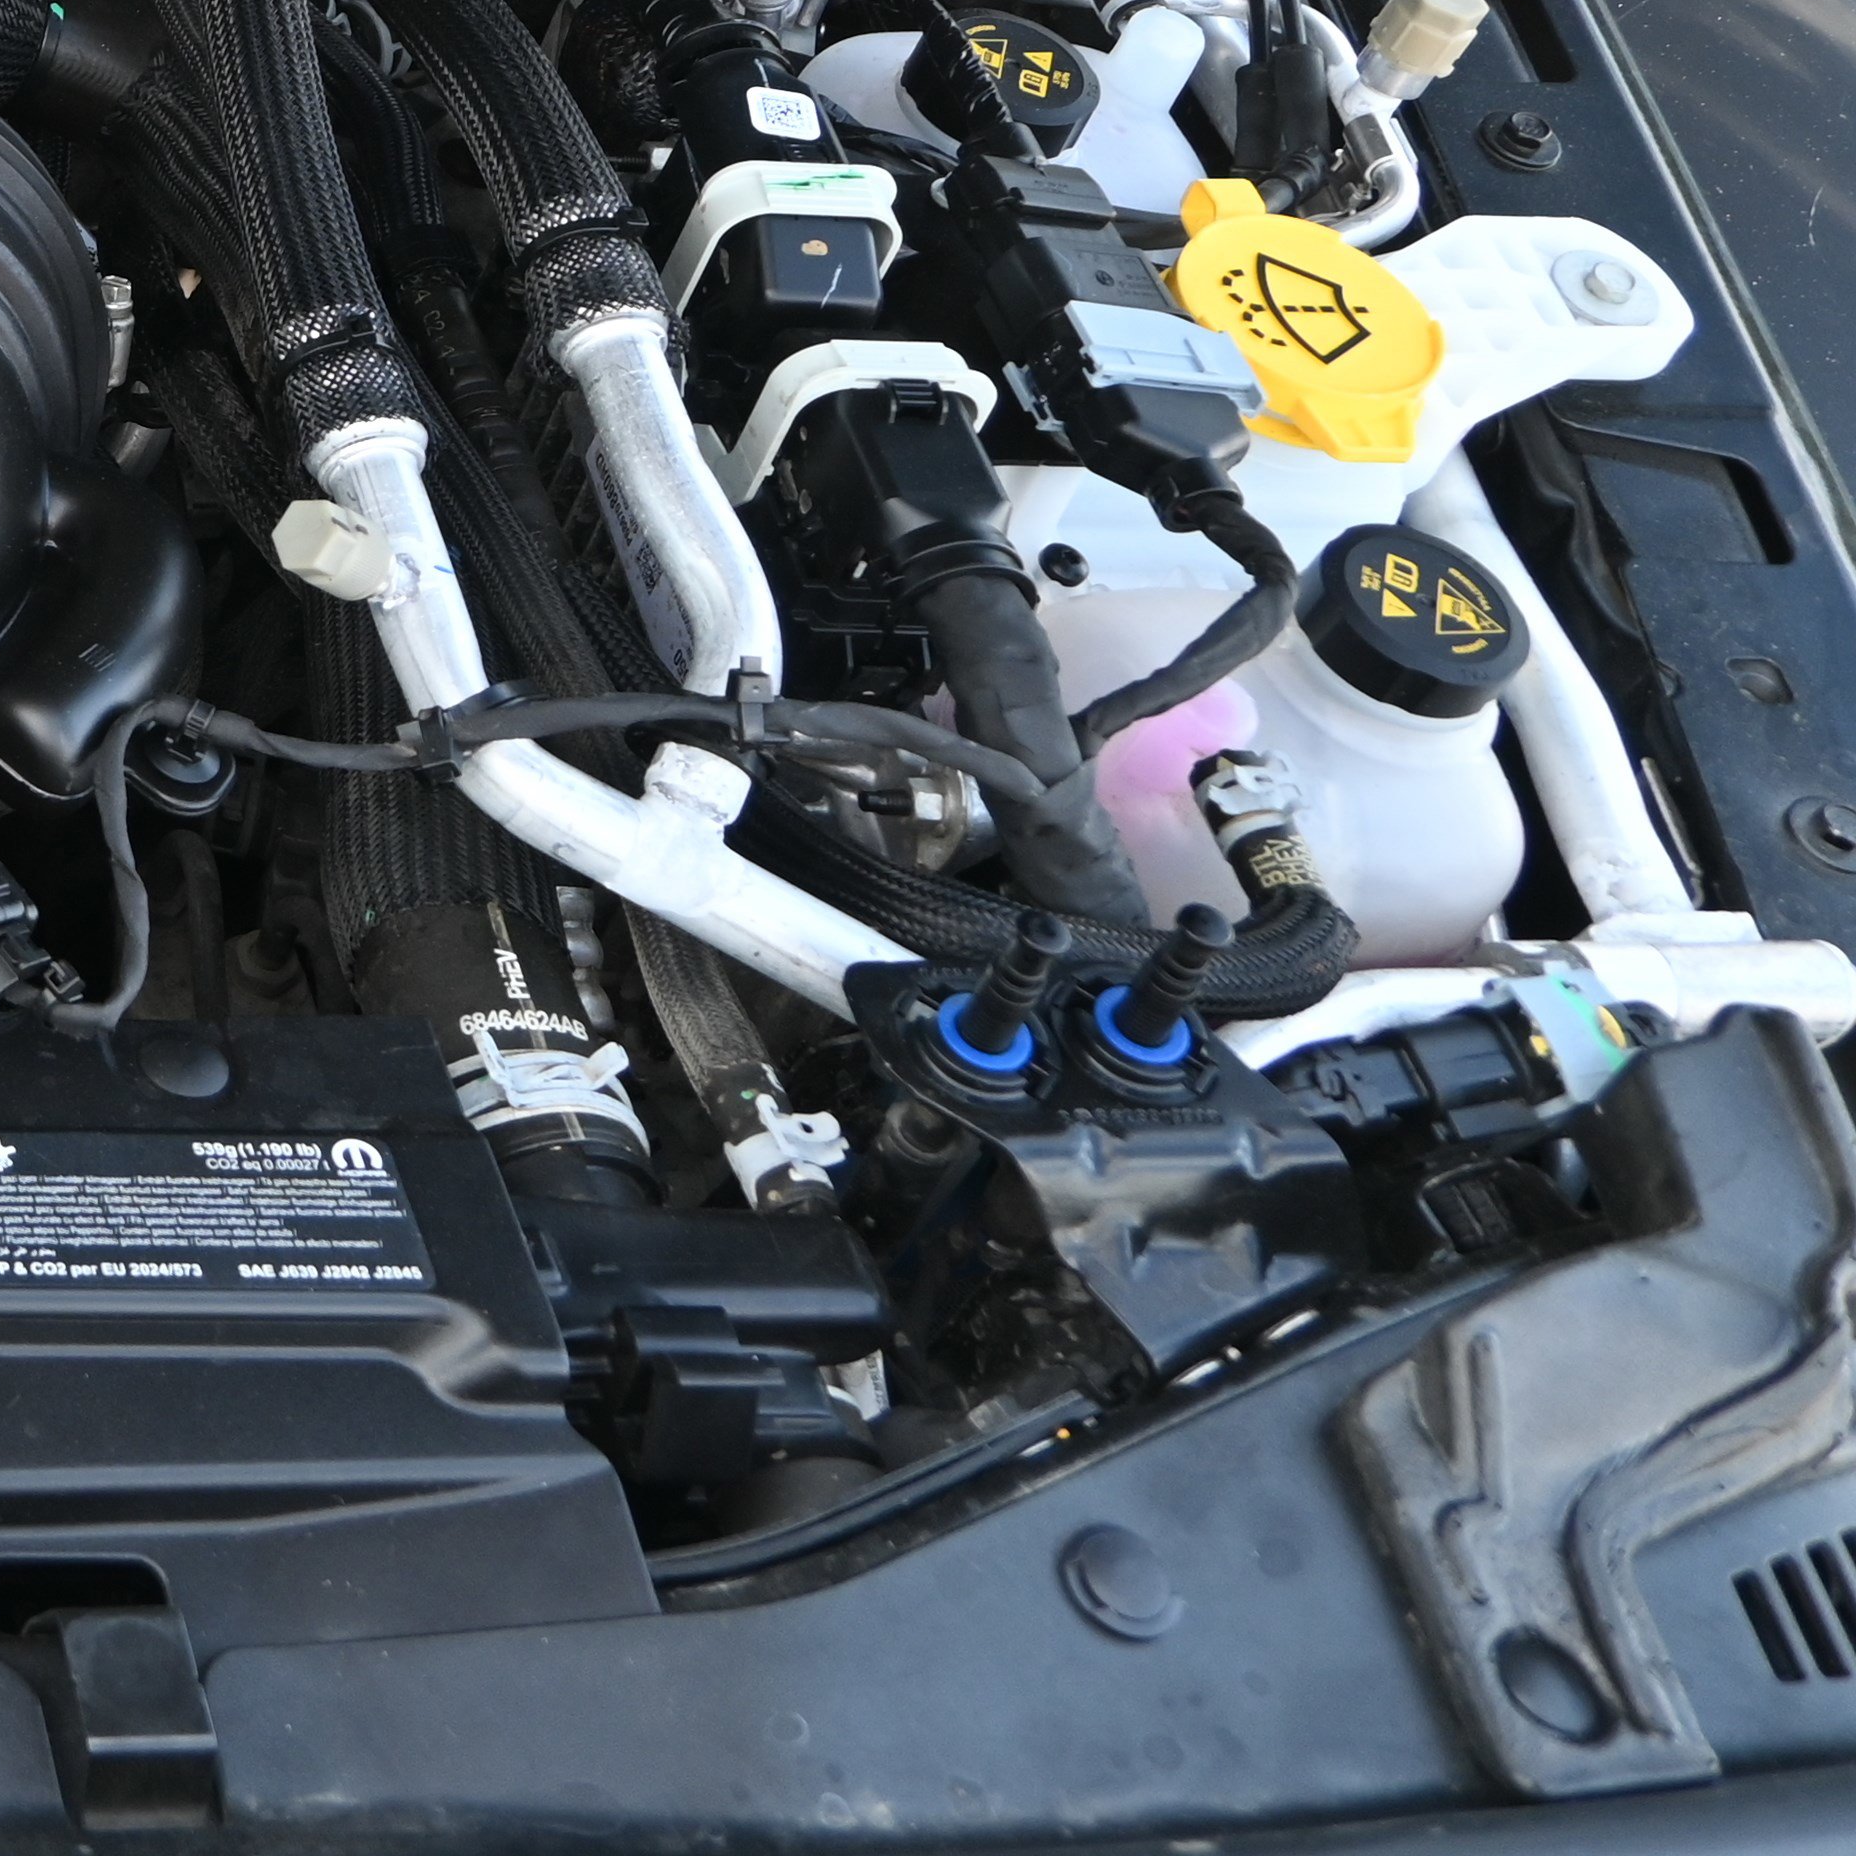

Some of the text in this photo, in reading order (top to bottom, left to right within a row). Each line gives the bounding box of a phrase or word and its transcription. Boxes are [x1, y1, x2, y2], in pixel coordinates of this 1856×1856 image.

[493, 948, 531, 1000] PHEV
[459, 1008, 589, 1042] 68464624AB
[205, 1158, 239, 1170] CO2
[13, 1261, 27, 1276] &
[30, 1262, 67, 1277] CO2
[70, 1264, 98, 1279] per
[101, 1262, 126, 1277] EU
[130, 1262, 203, 1278] 2024/573
[238, 1263, 276, 1279] SAE
[279, 1265, 318, 1279] J639
